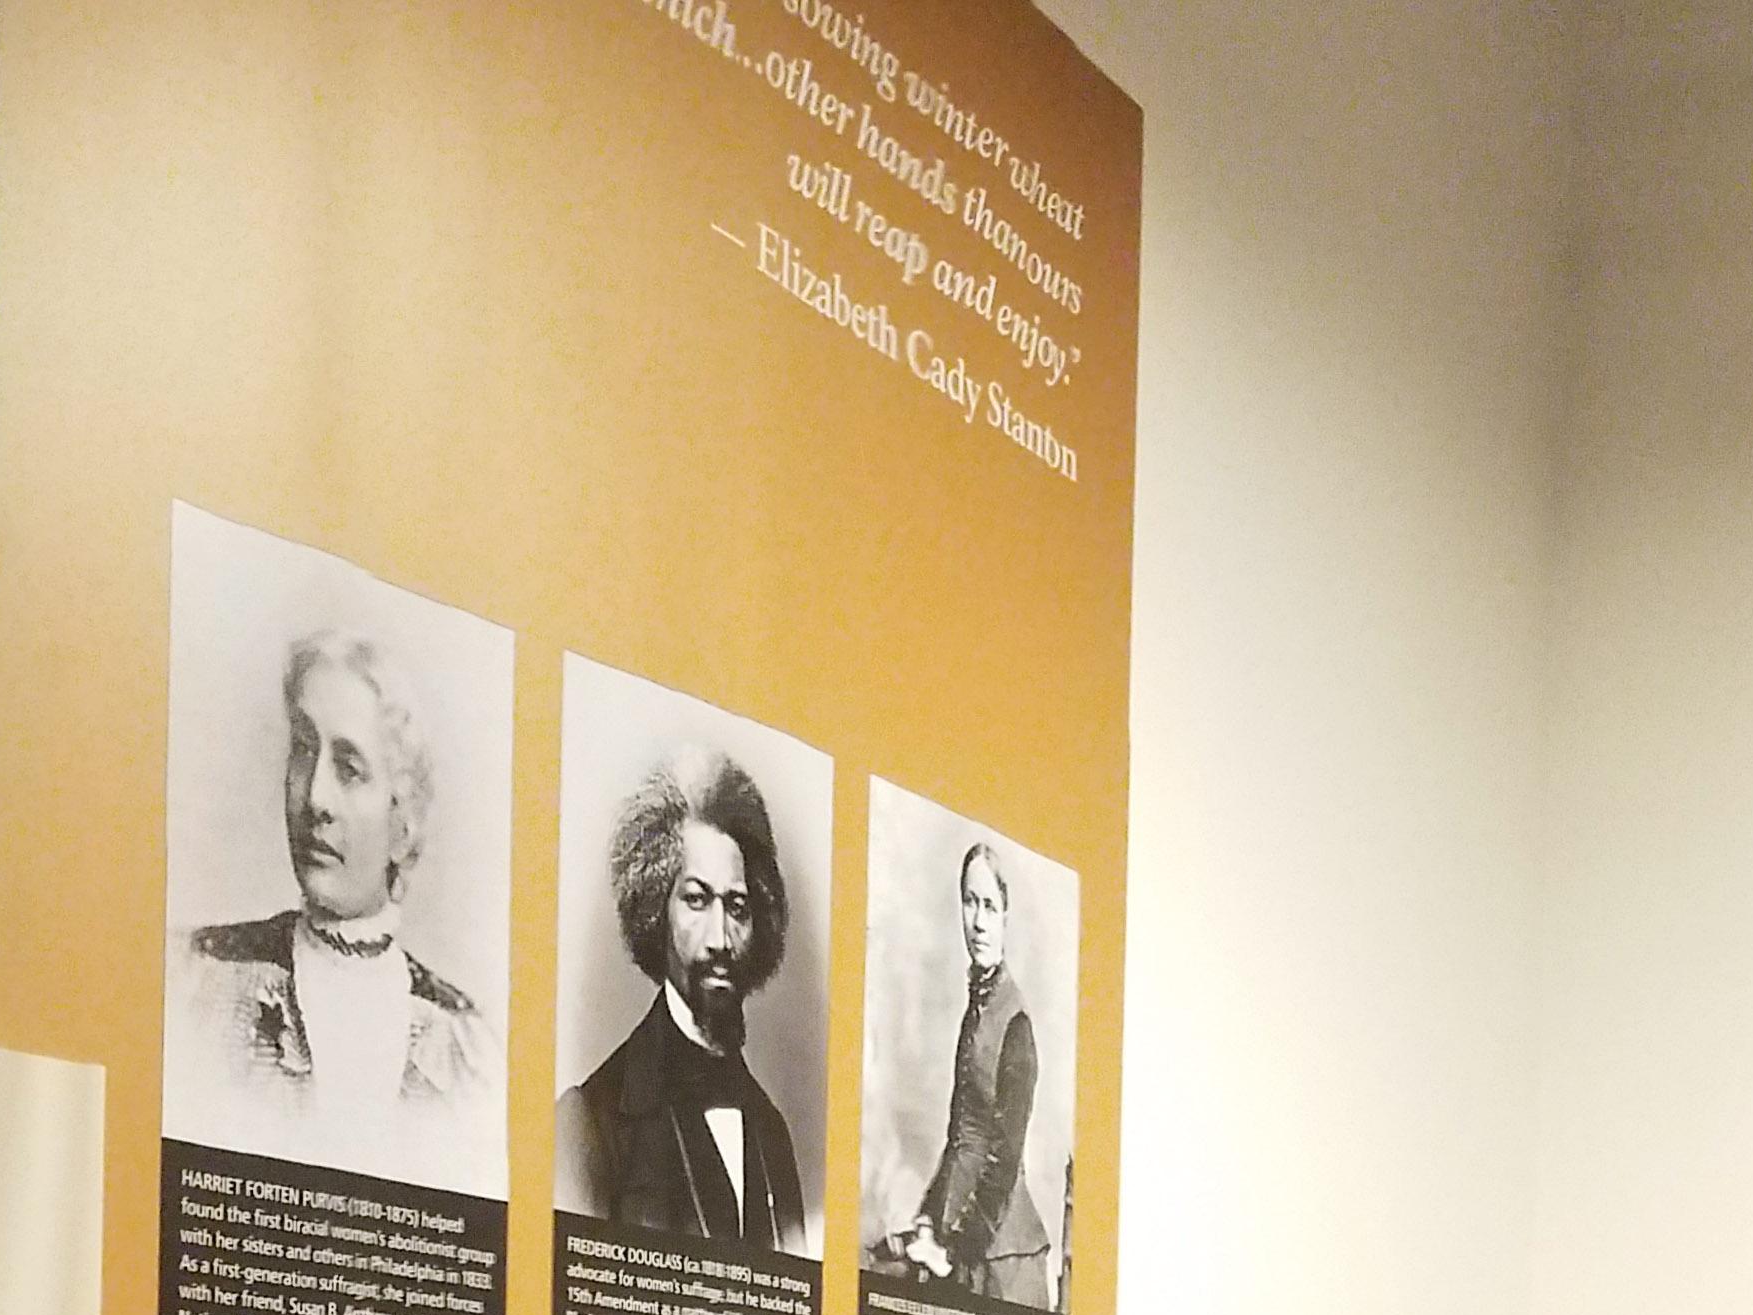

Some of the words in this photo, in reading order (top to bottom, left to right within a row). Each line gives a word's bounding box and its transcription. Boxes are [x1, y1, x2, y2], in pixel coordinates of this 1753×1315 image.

[786, 152, 851, 223] will
[854, 200, 929, 285] reap
[932, 259, 997, 321] and
[856, 104, 958, 215] hands
[903, 70, 1009, 167] winter
[1009, 157, 1085, 240] wheat
[756, 221, 901, 361] Elizabeth
[906, 329, 981, 424] Cady
[987, 381, 1078, 483] Stanton
[180, 1167, 244, 1195] HARRIET
[244, 1178, 300, 1206] FORTEN
